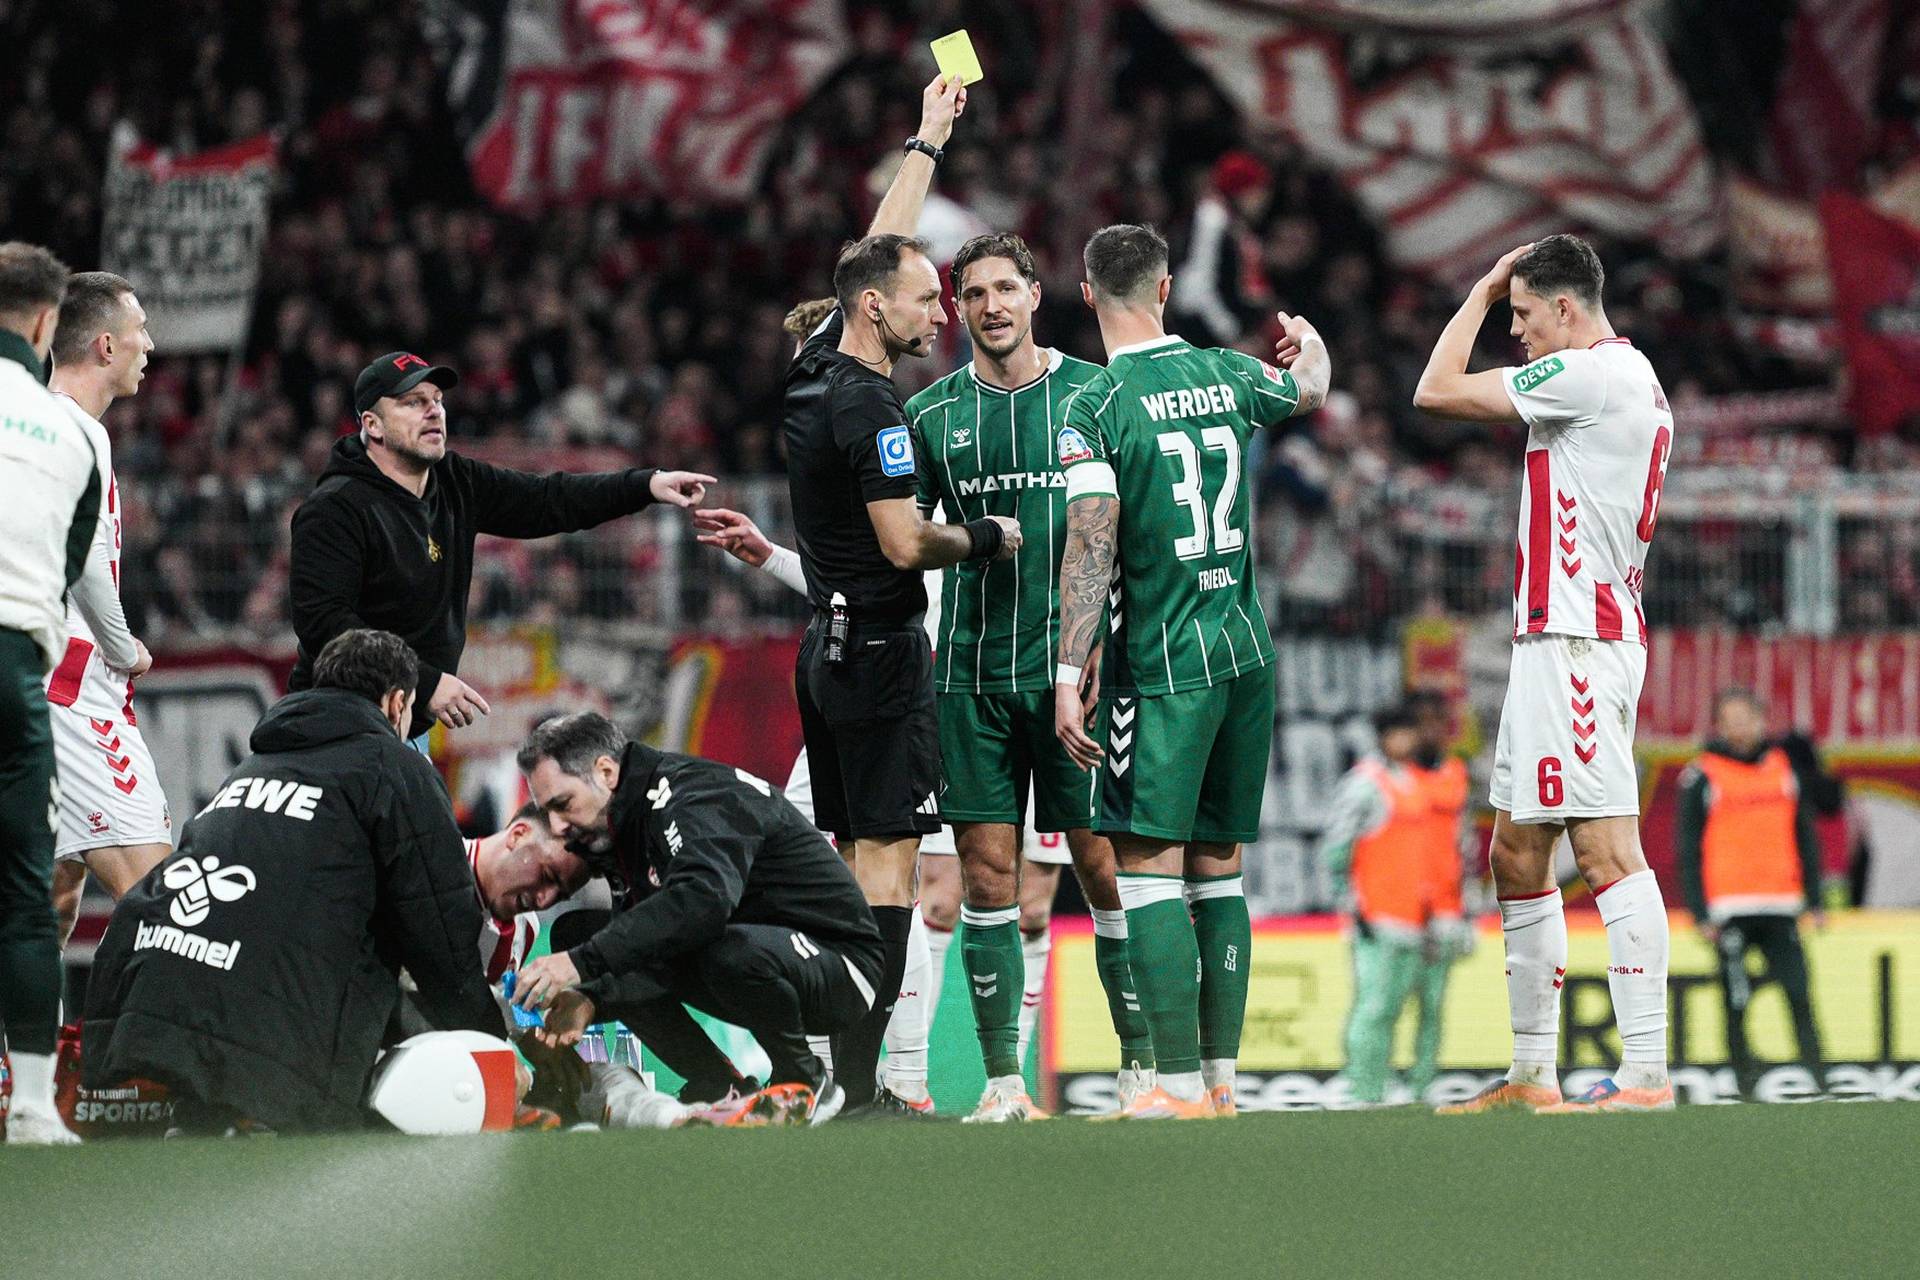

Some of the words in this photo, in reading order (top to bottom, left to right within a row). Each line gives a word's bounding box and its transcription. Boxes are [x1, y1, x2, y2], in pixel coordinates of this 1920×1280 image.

[1517, 359, 1559, 390] DEVK
[1139, 383, 1238, 422] WERDER
[1156, 425, 1244, 561] 32
[1198, 566, 1239, 592] FRIEDL
[1537, 756, 1564, 807] 6
[134, 919, 242, 971] hummel
